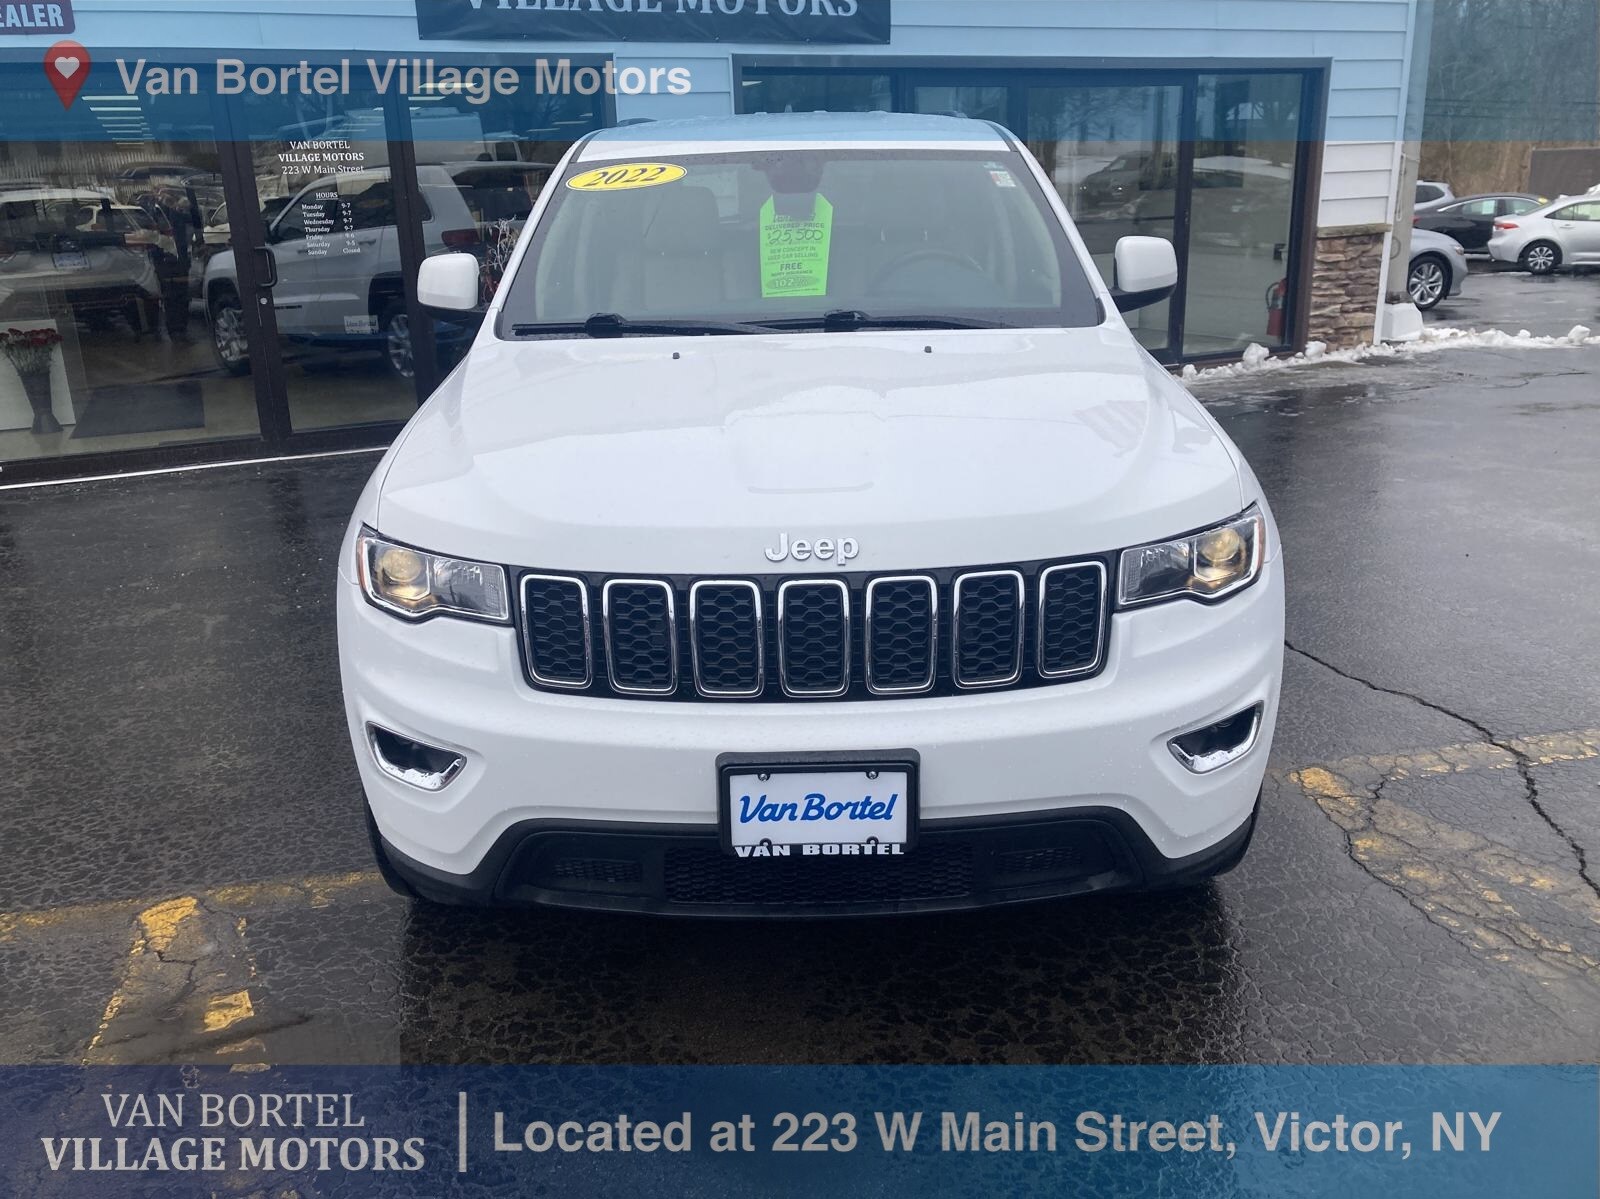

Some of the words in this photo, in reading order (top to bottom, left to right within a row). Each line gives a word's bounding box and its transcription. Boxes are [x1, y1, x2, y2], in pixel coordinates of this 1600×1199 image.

[289, 141, 310, 150] VAN
[313, 140, 351, 149] BORTEL
[278, 153, 321, 162] VILLAGE
[323, 152, 365, 161] MOTORS
[281, 165, 300, 175] 223
[301, 165, 312, 174] W
[314, 165, 336, 174] Main
[337, 164, 365, 173] Street
[582, 166, 667, 187] 2022
[315, 191, 339, 200] HOURS
[301, 203, 324, 211] Monday
[780, 262, 803, 271] FREE
[765, 531, 859, 566] Jeep
[735, 844, 791, 858] VAN
[803, 843, 904, 855] BORTEL
